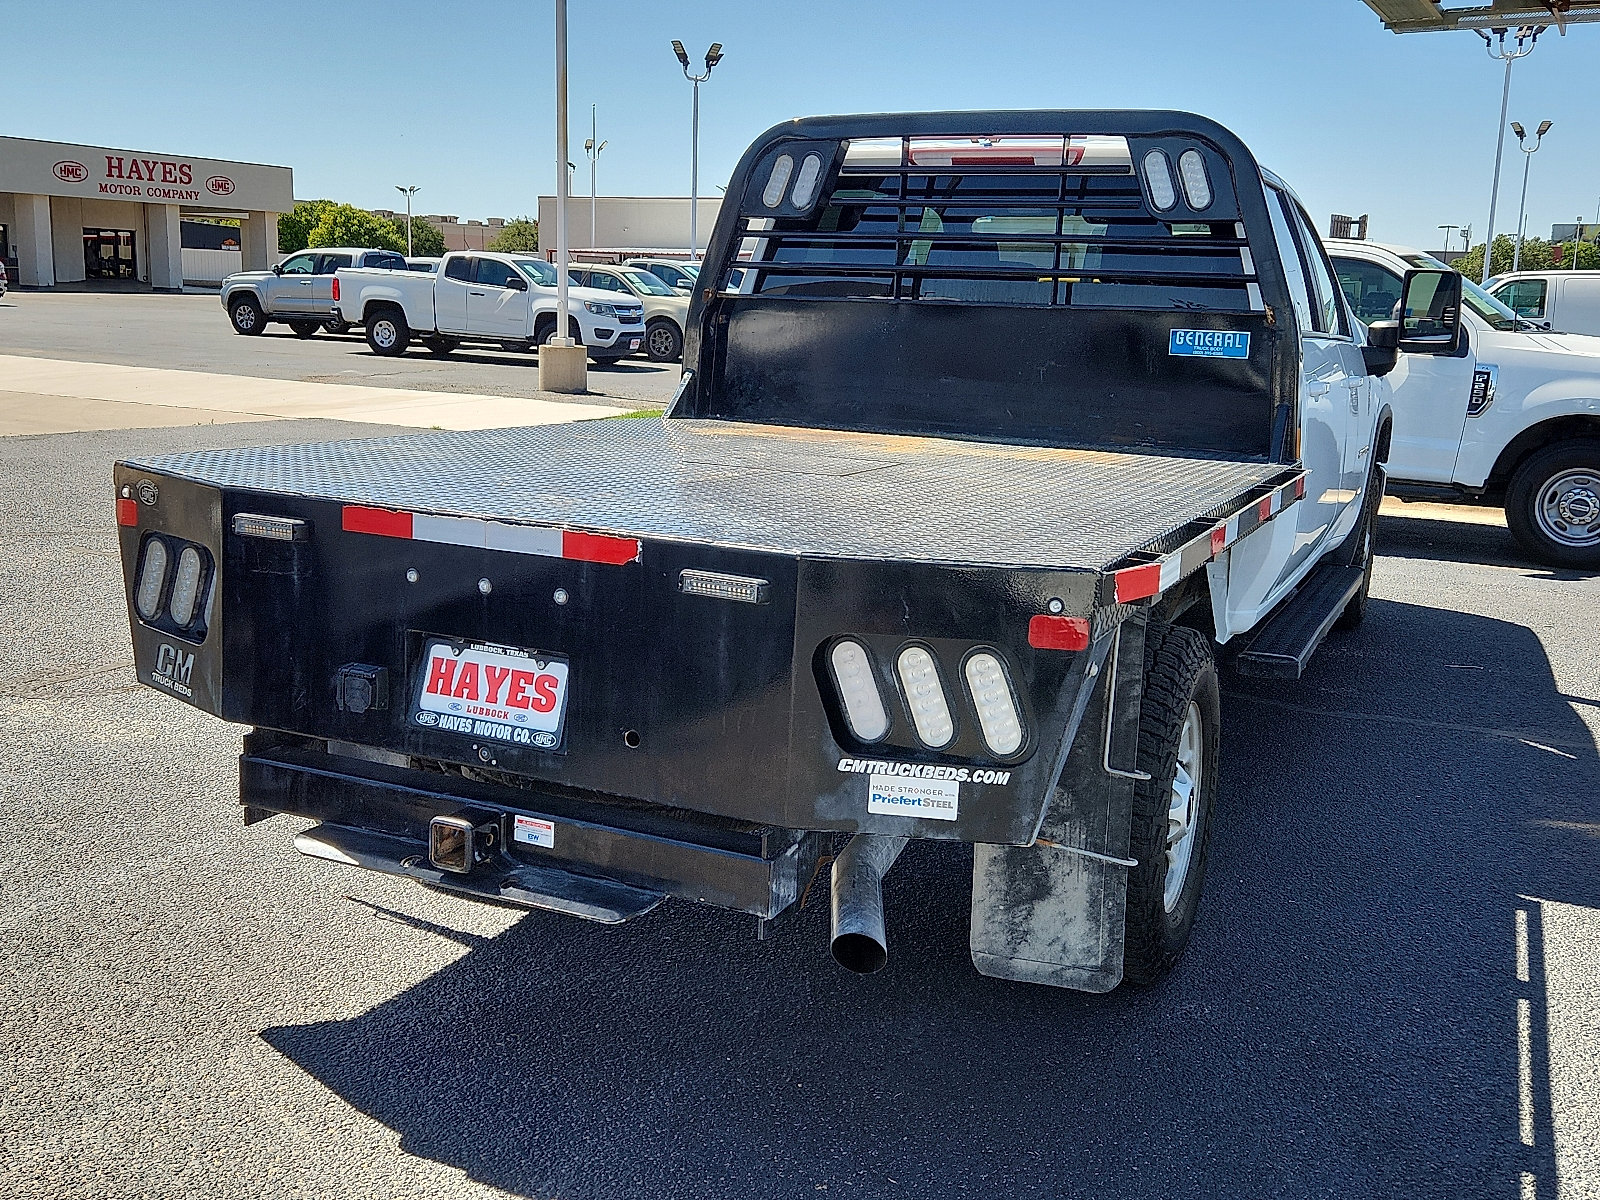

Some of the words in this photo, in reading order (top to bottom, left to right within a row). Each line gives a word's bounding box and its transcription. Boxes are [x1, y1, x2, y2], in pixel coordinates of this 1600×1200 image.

[59, 164, 82, 179] HMC
[105, 156, 193, 185] HAYES
[98, 183, 142, 196] MOTOR
[147, 187, 200, 201] COMPANY
[211, 179, 230, 192] HMC
[1175, 331, 1243, 348] GENERAL
[506, 649, 529, 659] TEXAS
[155, 643, 195, 686] CM
[151, 672, 175, 689] TRUCK
[174, 682, 192, 697] BEDS
[426, 656, 559, 713] HAYES
[466, 705, 510, 720] LUBBOCK
[438, 715, 473, 734] HAYES
[473, 721, 512, 741] MOTOR
[513, 729, 531, 744] CO.
[837, 758, 1011, 786] CMTRUCKBEDS.COM
[872, 784, 896, 792] MADE
[898, 787, 944, 797] STRONGER
